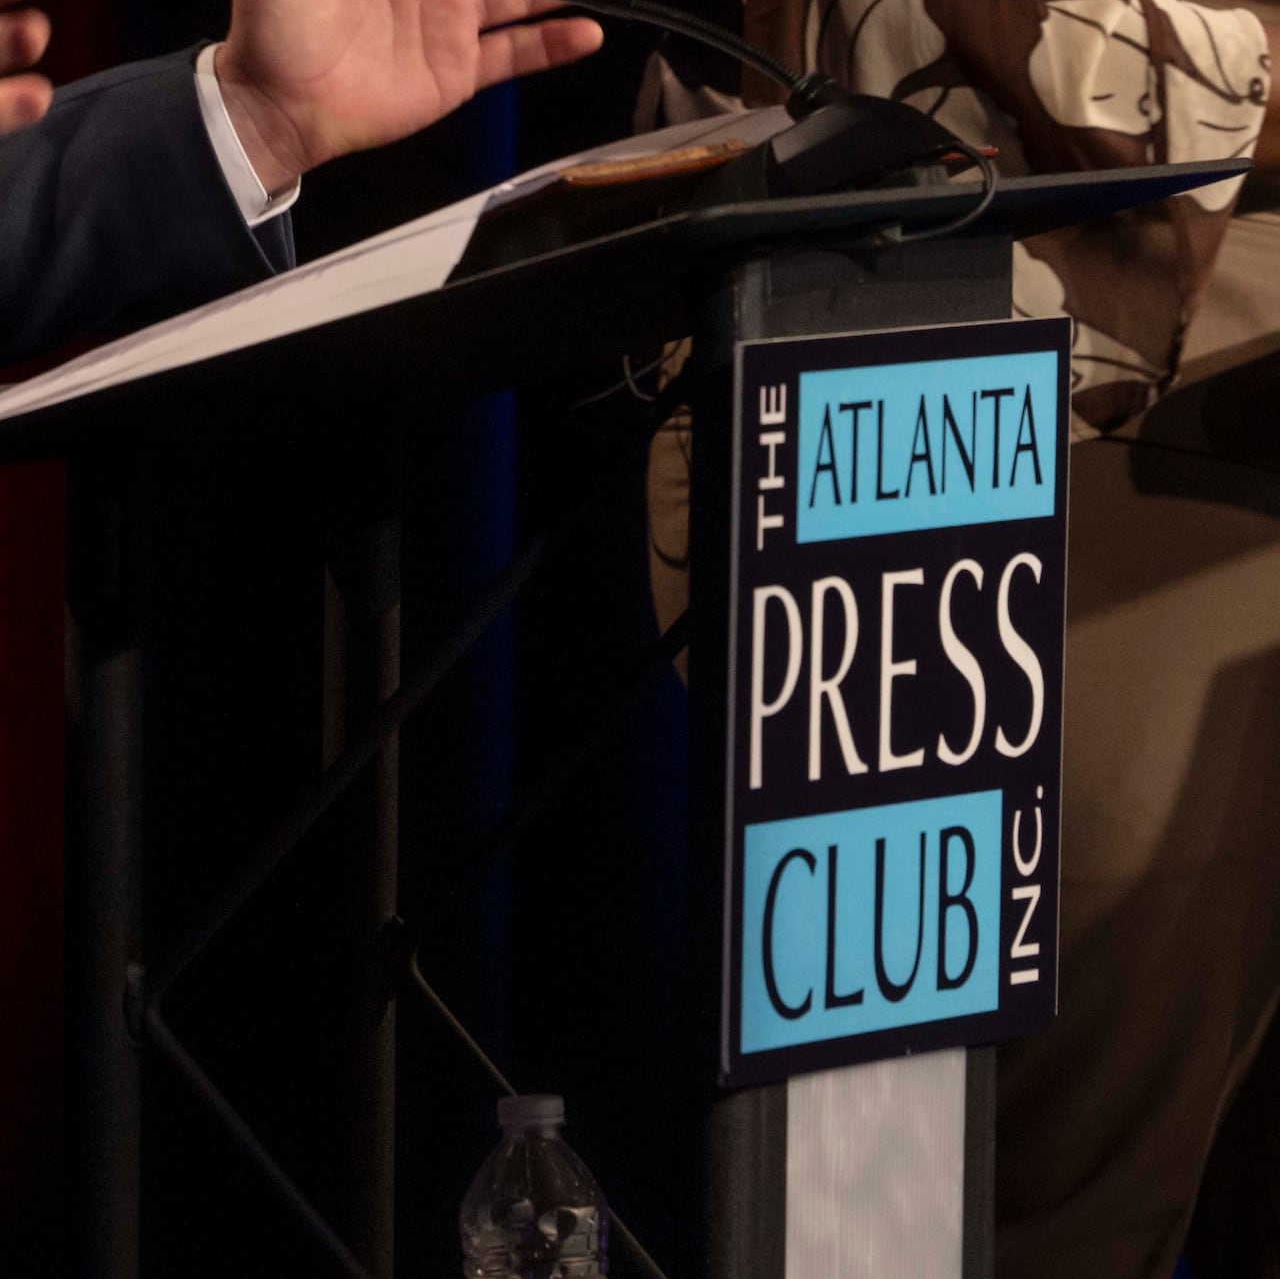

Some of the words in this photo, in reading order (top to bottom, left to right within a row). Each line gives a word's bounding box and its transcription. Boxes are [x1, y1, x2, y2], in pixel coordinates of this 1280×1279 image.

[756, 382, 787, 550] THE
[808, 383, 1044, 508] ATLANTA
[748, 552, 1046, 790] PRESS
[760, 825, 980, 1020] CLUB
[1010, 784, 1044, 985] INC.
